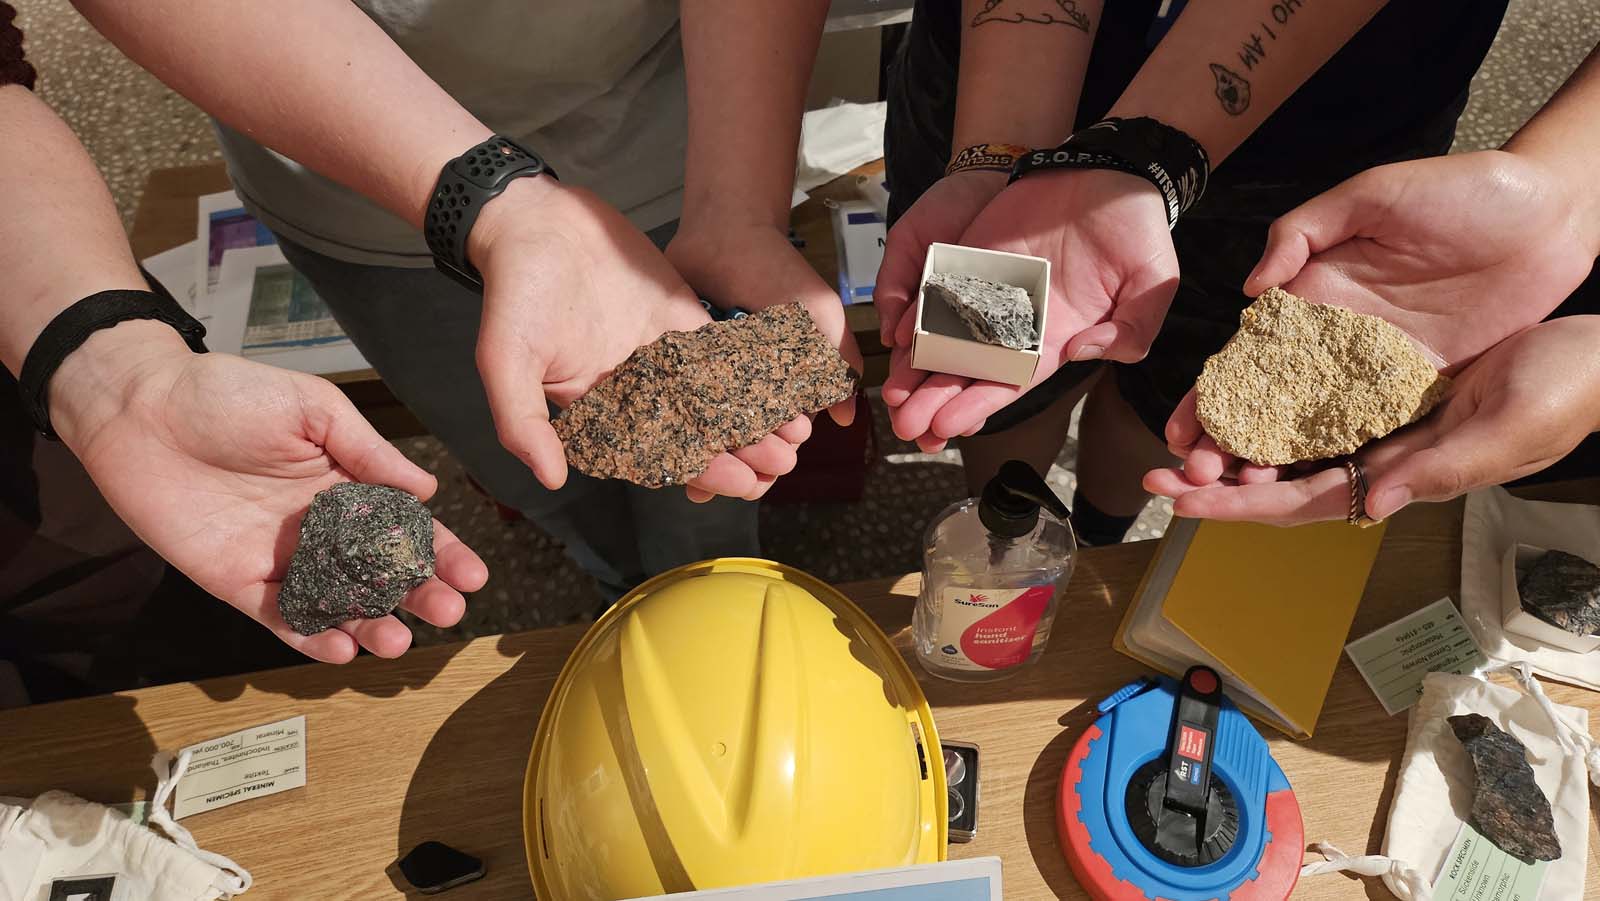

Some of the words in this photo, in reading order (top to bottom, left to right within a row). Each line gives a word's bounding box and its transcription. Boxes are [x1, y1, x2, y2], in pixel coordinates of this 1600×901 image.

[1261, 22, 1276, 40] I
[1238, 33, 1265, 71] AM
[953, 598, 999, 608] SureSan
[255, 728, 285, 741] Mineral
[242, 781, 275, 793] MINERAL
[206, 788, 241, 804] SPECIMEN
[1457, 838, 1472, 865] SPECIMEN
[1492, 872, 1510, 901] amorphic
